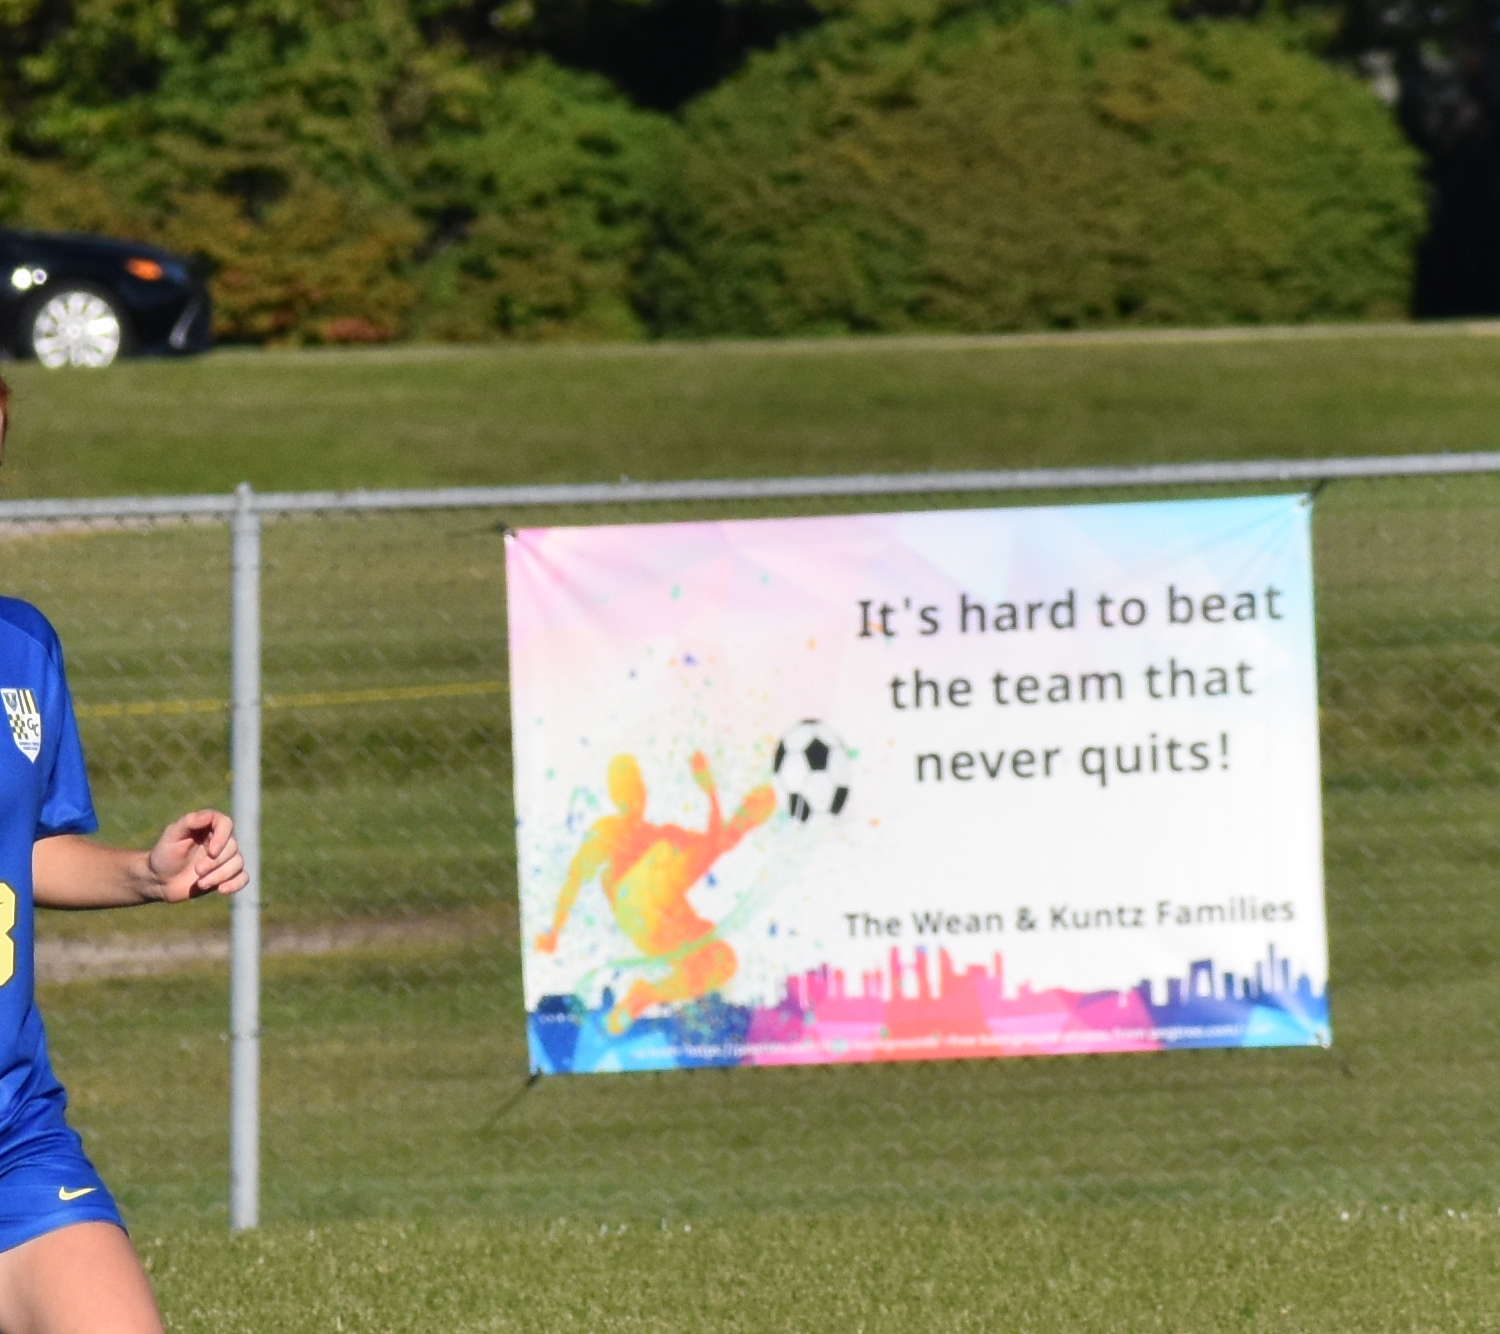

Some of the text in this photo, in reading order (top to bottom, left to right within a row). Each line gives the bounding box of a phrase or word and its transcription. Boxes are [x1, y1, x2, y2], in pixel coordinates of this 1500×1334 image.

[856, 585, 1283, 638] It's hard to beat
[889, 658, 1256, 710] the team that
[915, 733, 1231, 788] never quits!
[844, 896, 1297, 938] The Wean & Kuntz Families
